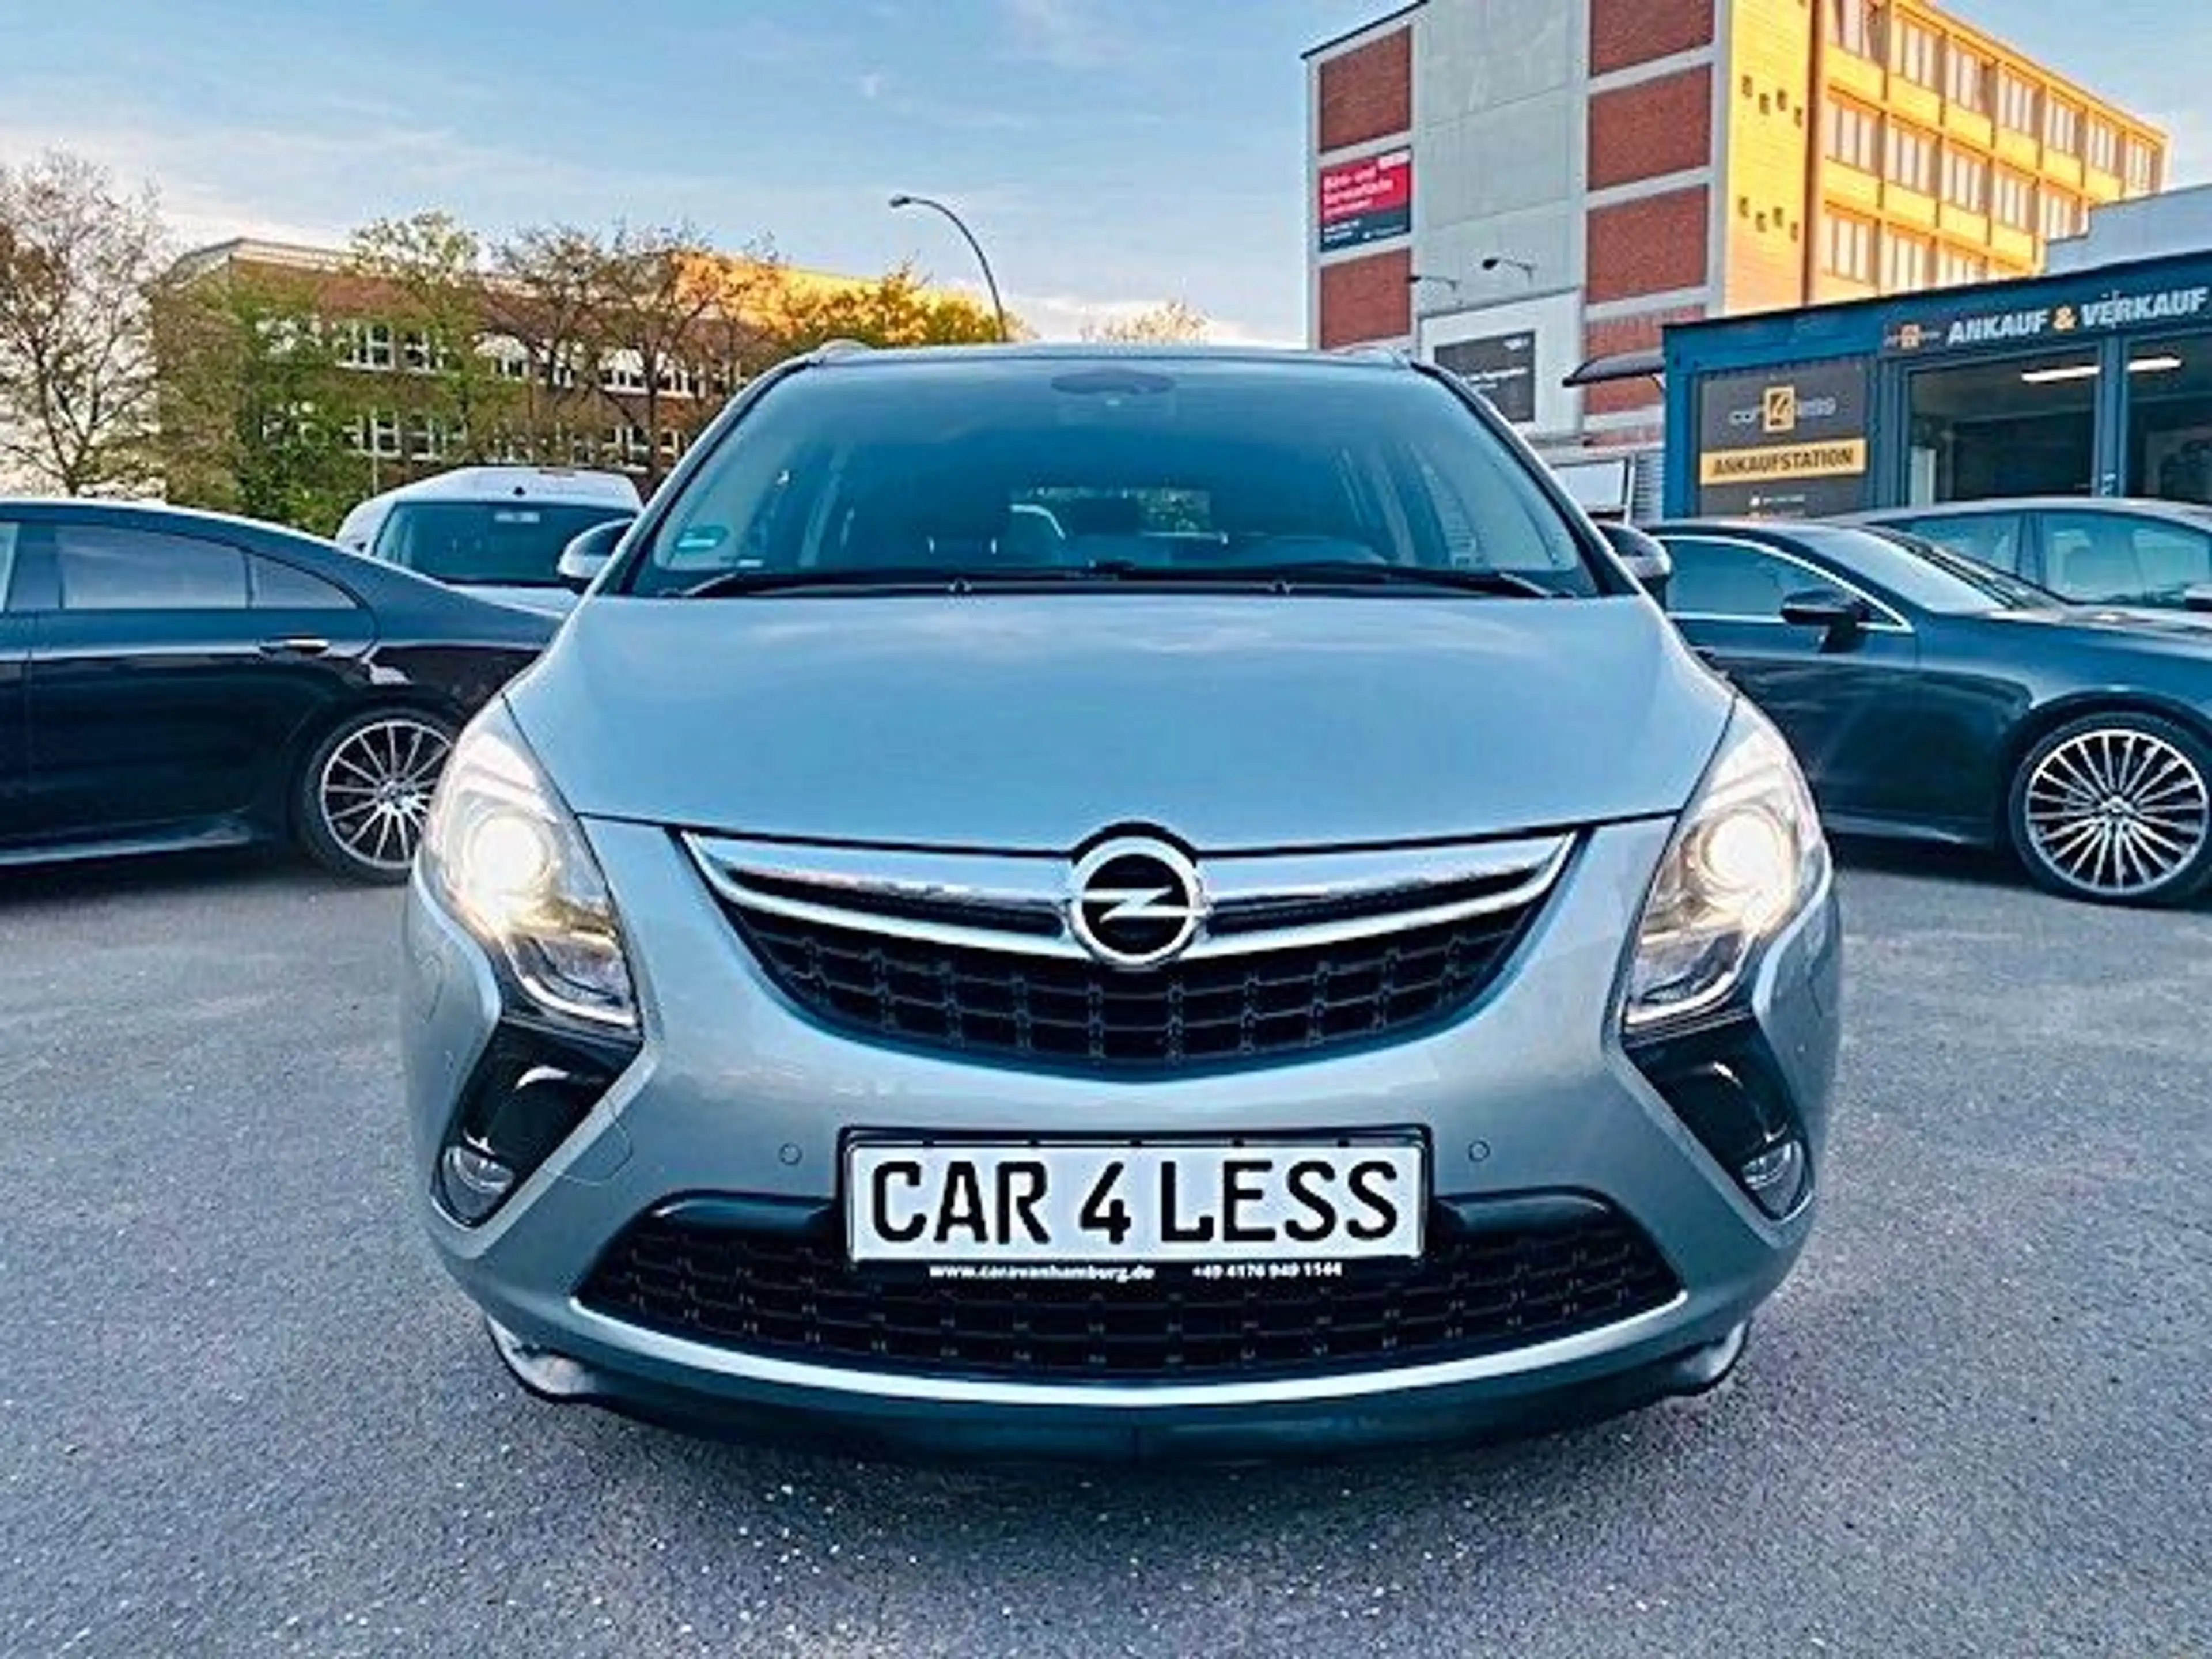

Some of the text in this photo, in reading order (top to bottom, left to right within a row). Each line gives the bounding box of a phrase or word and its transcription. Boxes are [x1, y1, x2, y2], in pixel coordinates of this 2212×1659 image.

[1946, 286, 2210, 346] ANKAUF & VERKAUF
[1712, 447, 1854, 476] ANKAUFSTATION
[873, 1160, 1398, 1244] CAR 4 LESS
[1192, 1264, 1223, 1279] +49
